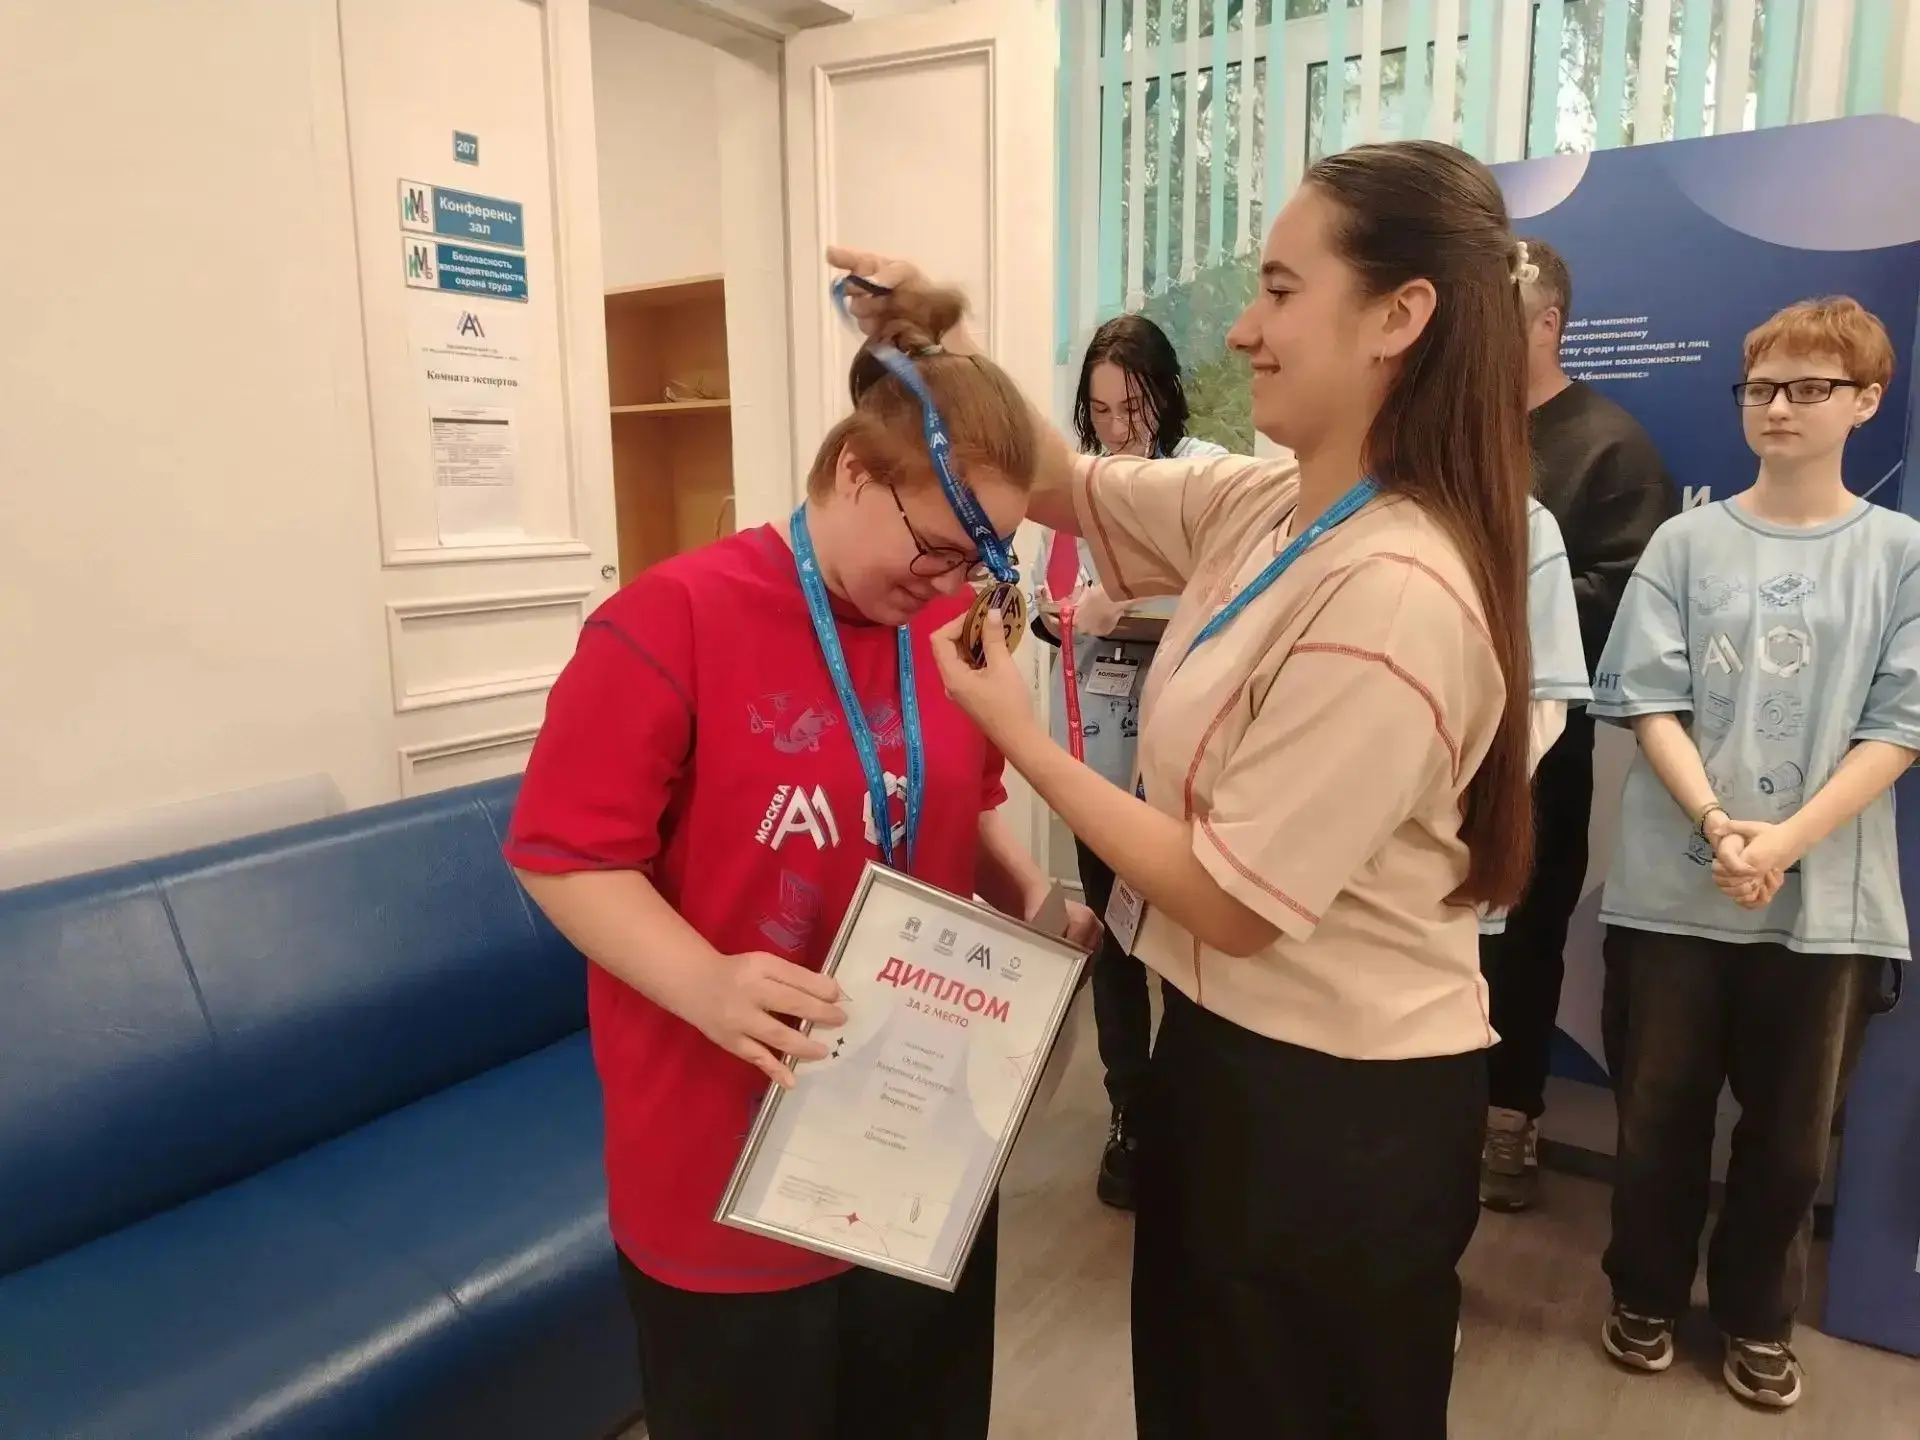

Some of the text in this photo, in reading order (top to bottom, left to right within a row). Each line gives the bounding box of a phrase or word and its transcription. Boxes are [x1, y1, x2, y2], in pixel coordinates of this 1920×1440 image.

[456, 140, 476, 155] 207
[439, 197, 517, 223] Конференц-
[468, 222, 491, 235] зал
[452, 251, 513, 269] Безопасность
[455, 277, 513, 293] охрана труда
[1590, 315, 1649, 327] чемпионат
[1583, 344, 1615, 356] среди
[1617, 341, 1677, 352] инвалидов
[1678, 341, 1686, 349] и
[1688, 339, 1710, 349] лиц
[1615, 354, 1702, 366] возможностями
[427, 370, 518, 388] Комната экспертов
[755, 784, 792, 845] МОСКВА
[876, 956, 1011, 1023] ДИПЛОМ
[905, 996, 969, 1028] ЗА 2 МЕСТО
